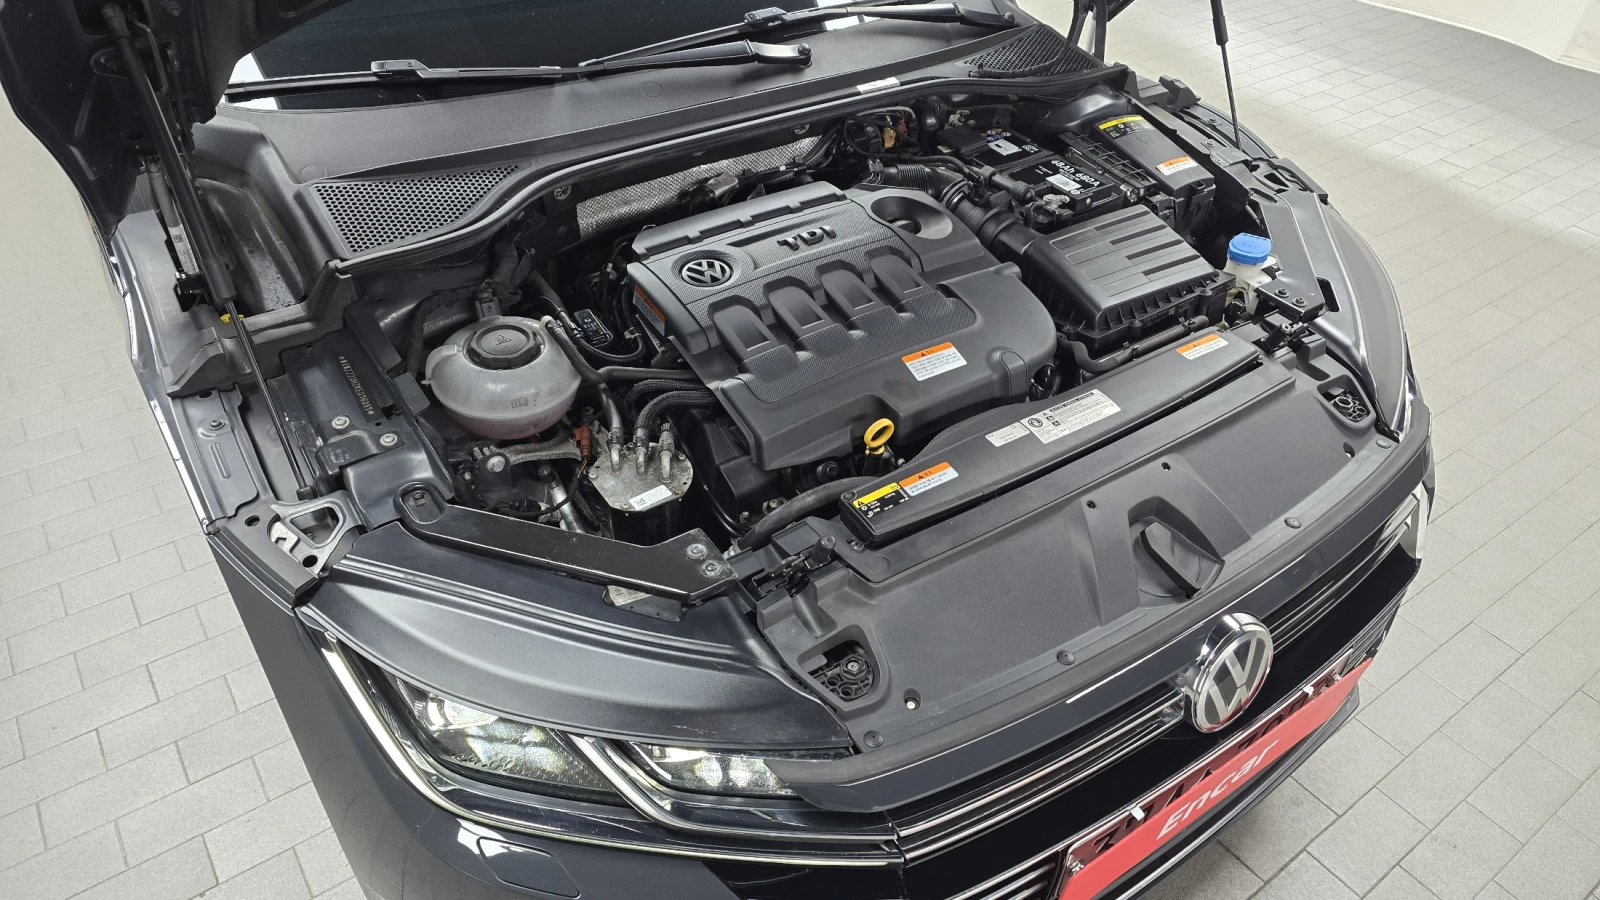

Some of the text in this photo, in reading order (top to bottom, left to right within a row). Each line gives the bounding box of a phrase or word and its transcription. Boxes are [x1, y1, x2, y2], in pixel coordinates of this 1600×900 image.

[1051, 160, 1075, 173] 68Ah
[1075, 173, 1101, 187] 680A
[776, 225, 837, 251] TDI
[1156, 739, 1279, 840] Encar
